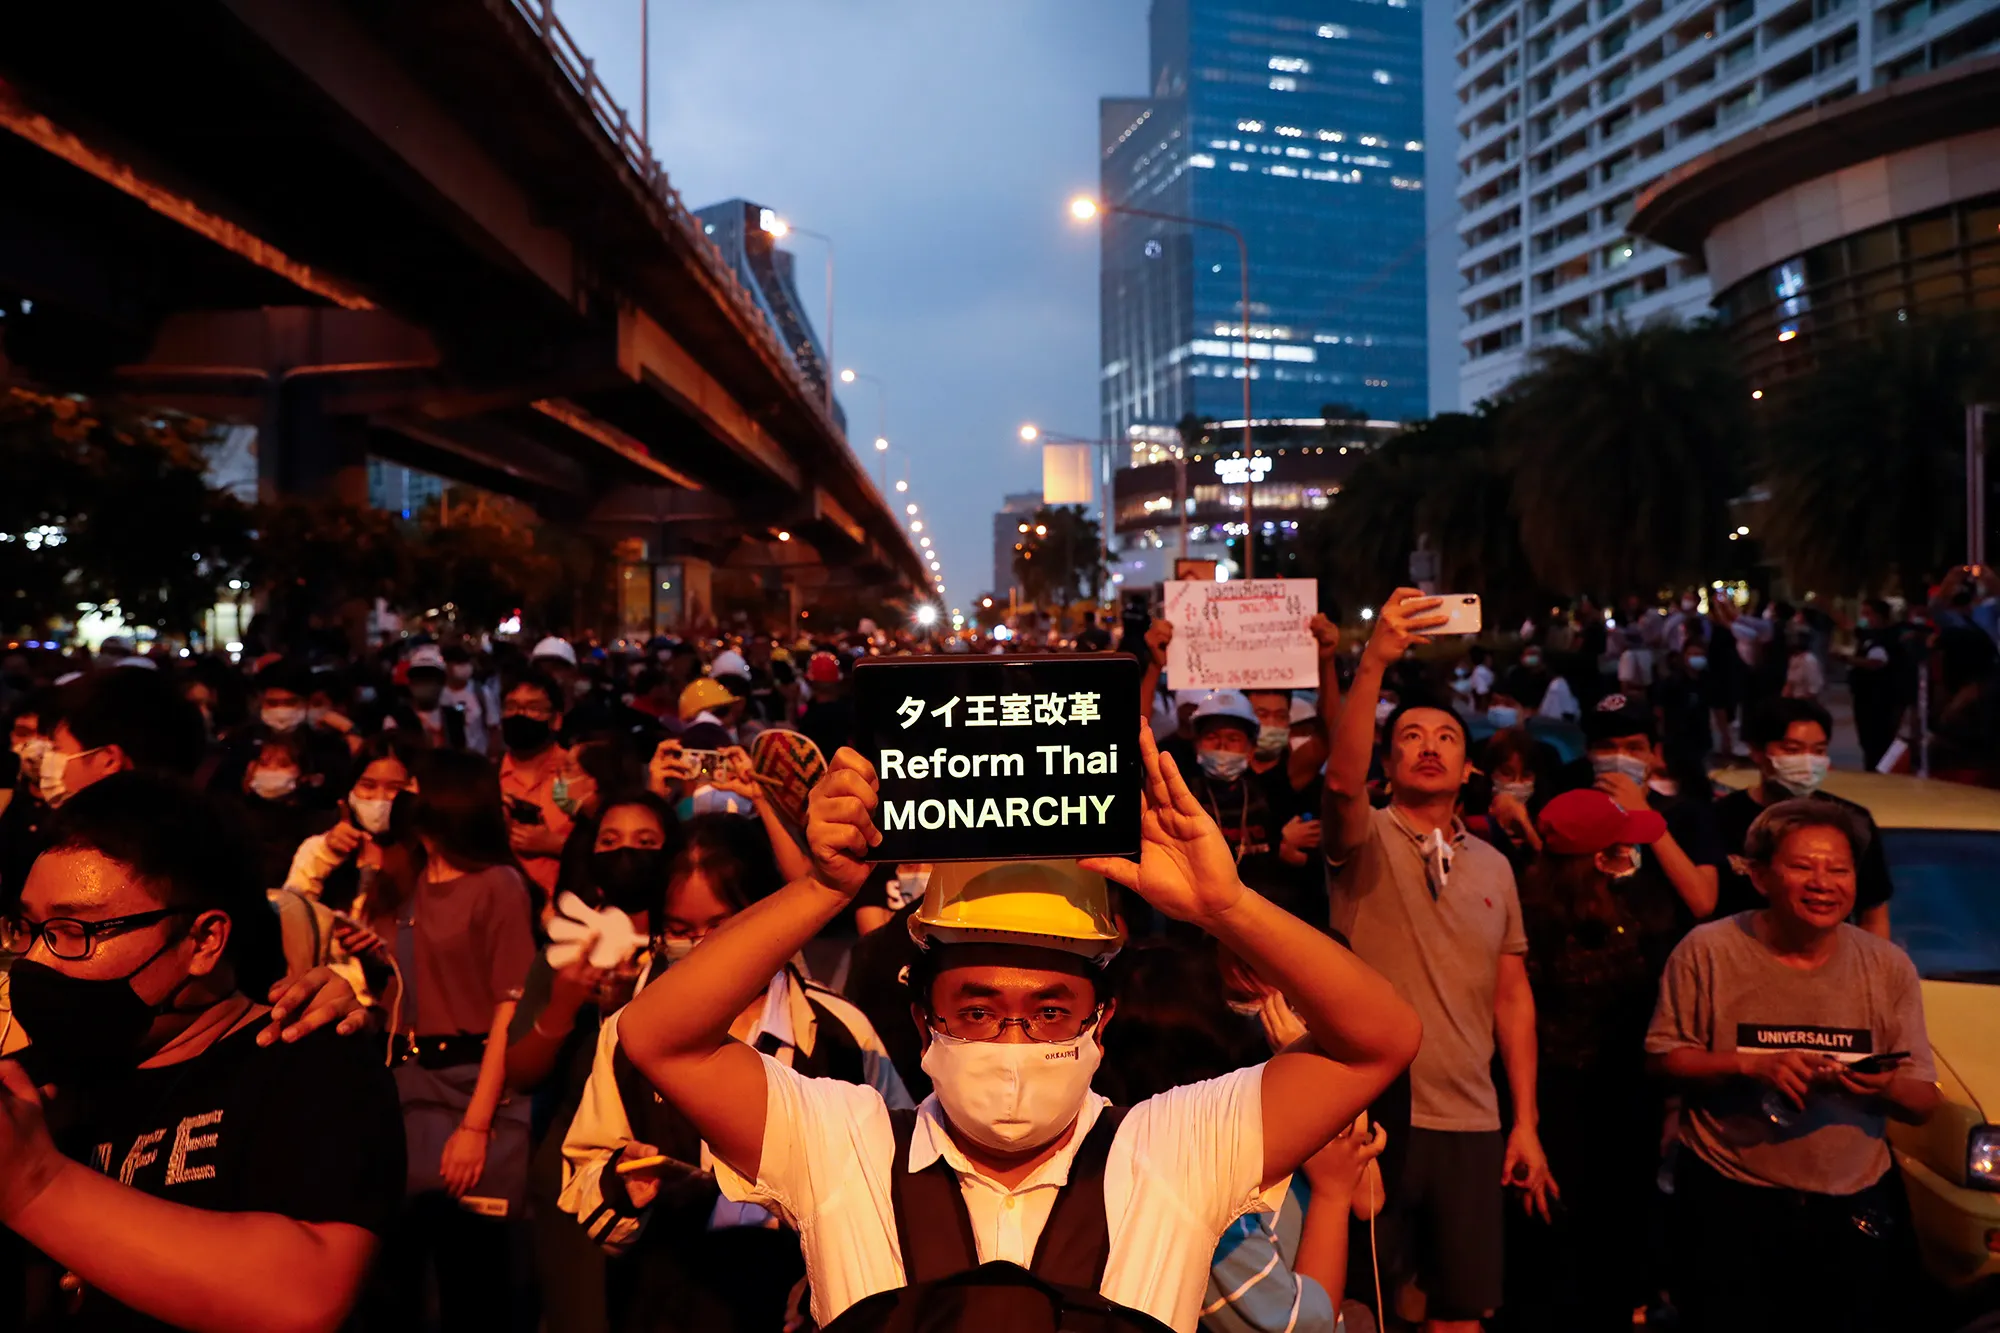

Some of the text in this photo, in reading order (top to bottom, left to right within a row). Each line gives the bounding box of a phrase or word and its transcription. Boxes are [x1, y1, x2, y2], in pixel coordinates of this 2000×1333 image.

[896, 692, 1101, 729] タイ王室改革
[880, 744, 1118, 780] Reform Thai
[883, 795, 1116, 831] MONARCHY
[1757, 1030, 1853, 1047] UNIVERSALITY
